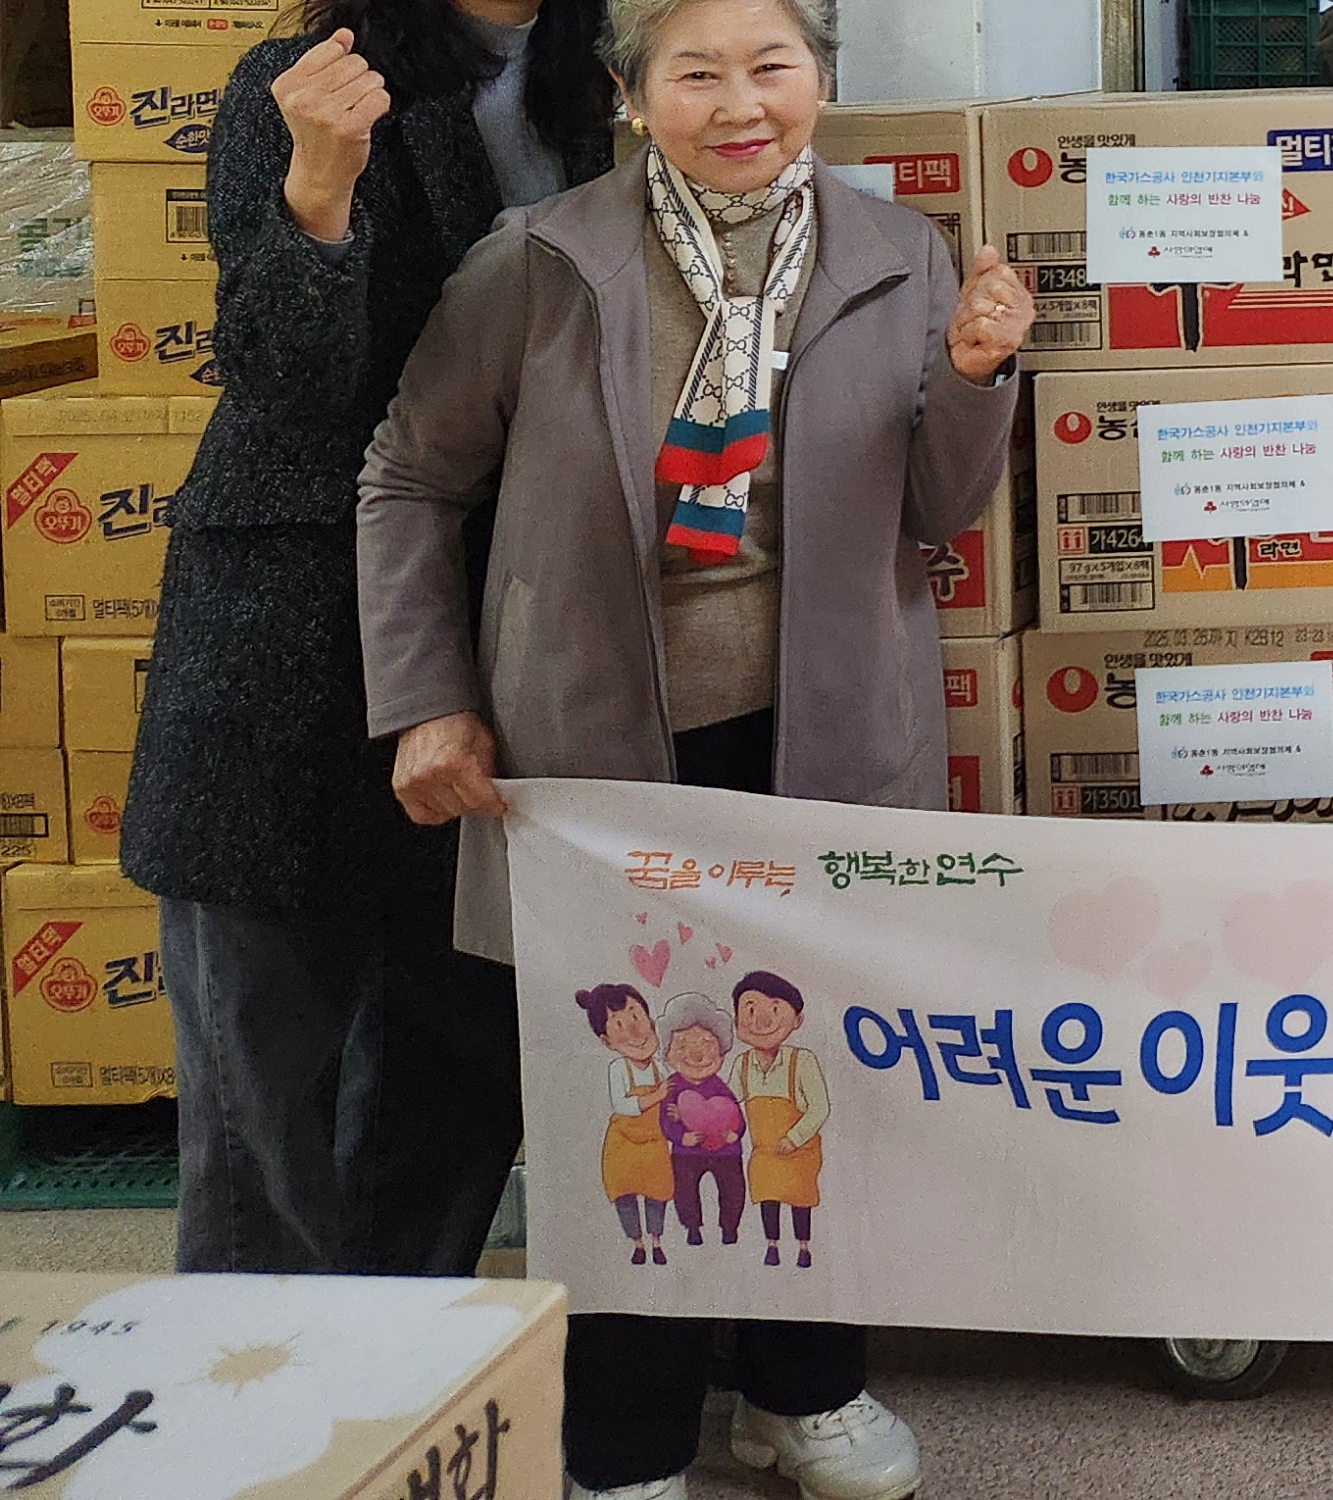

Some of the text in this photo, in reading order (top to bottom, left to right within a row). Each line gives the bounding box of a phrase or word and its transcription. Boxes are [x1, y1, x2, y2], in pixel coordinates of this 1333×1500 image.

[625, 851, 700, 890] 꿈을
[707, 855, 796, 895] 이루는
[844, 1002, 1123, 1125] 어려운
